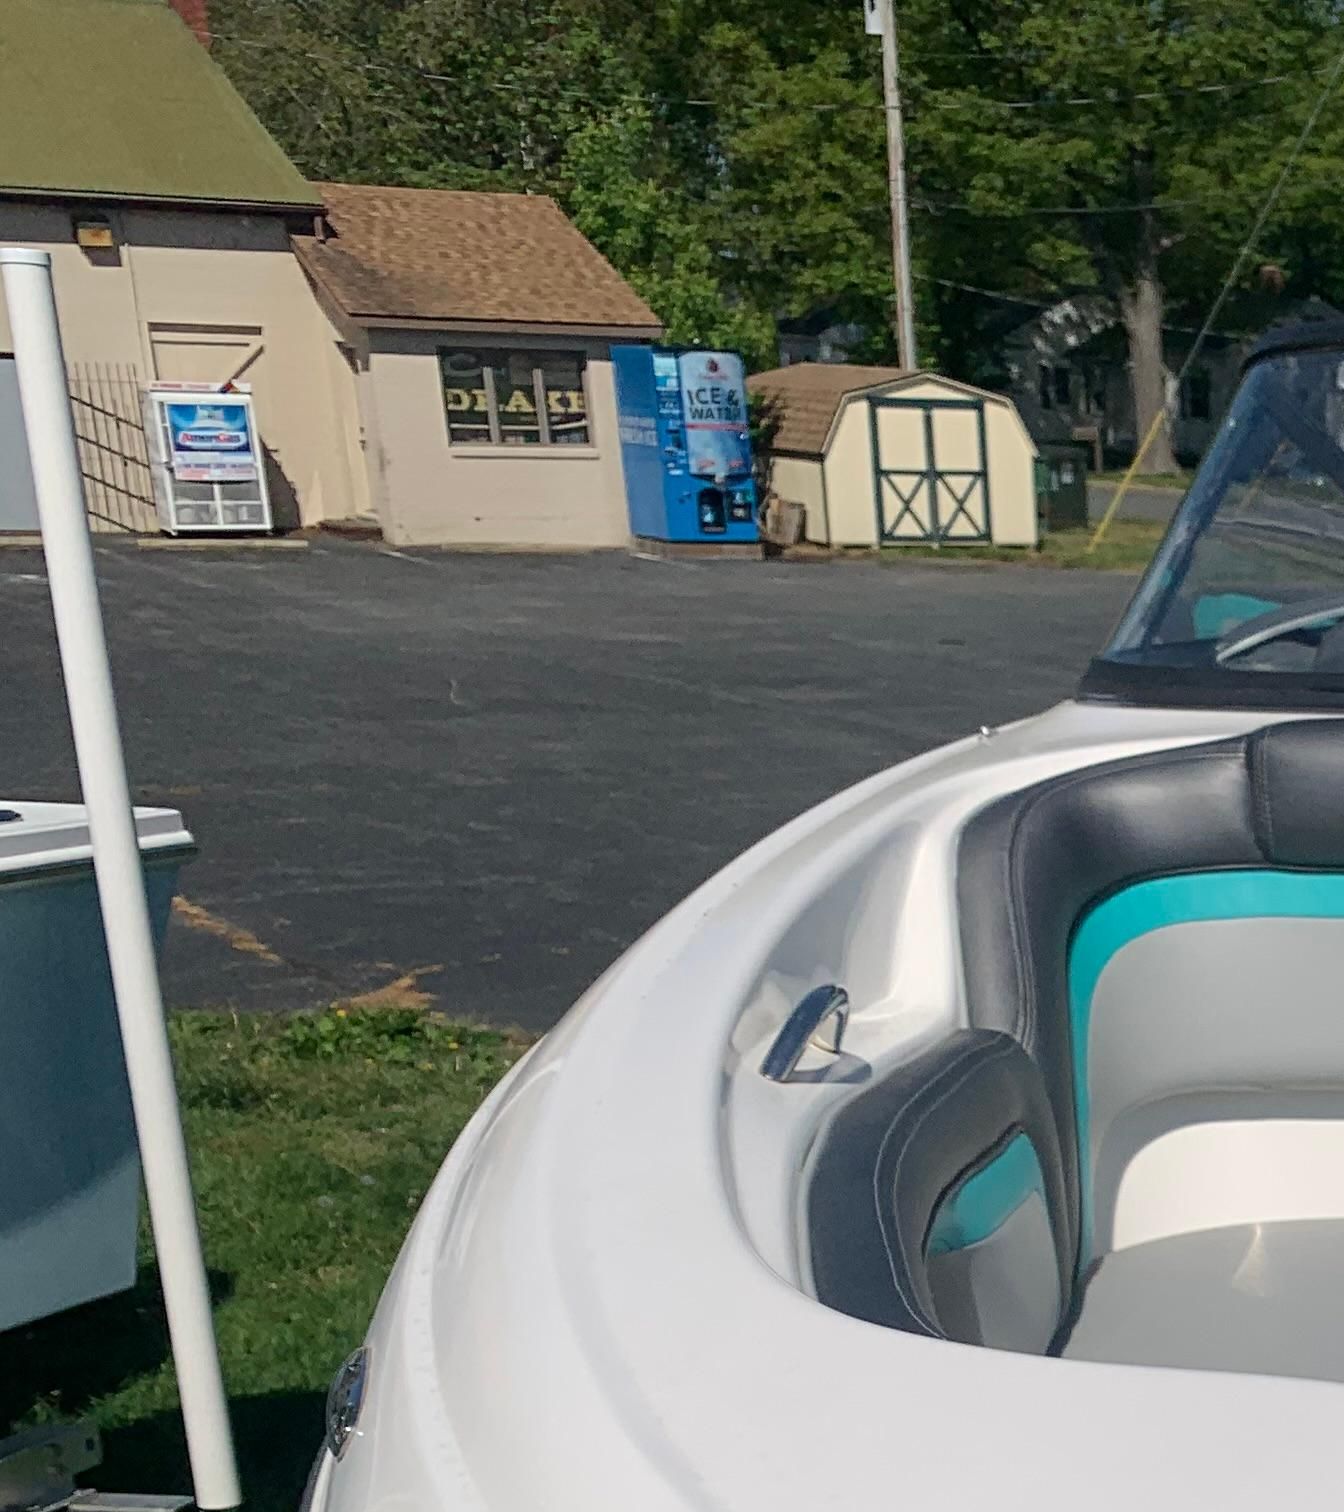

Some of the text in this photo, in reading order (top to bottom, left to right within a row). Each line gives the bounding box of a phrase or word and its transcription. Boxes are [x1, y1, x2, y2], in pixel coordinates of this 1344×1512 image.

[686, 387, 739, 408] ICE &
[689, 405, 741, 421] WATER
